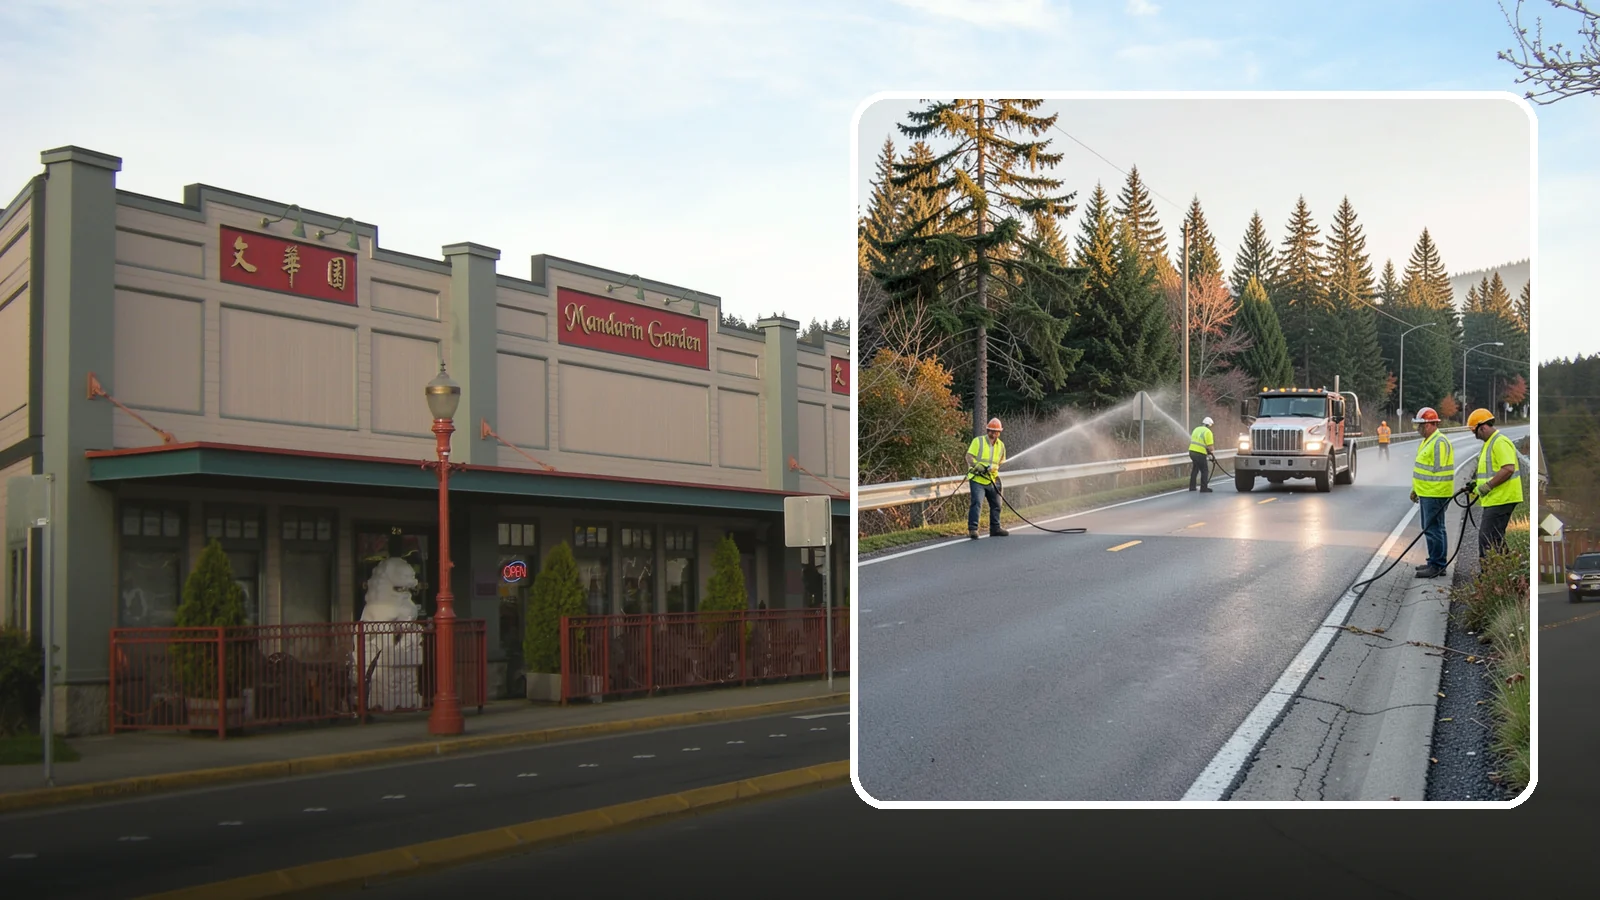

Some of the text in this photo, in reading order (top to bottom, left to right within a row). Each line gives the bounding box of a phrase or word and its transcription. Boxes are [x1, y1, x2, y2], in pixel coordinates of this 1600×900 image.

[231, 236, 346, 290] 文華園
[564, 302, 701, 352] Mandarin Garden
[834, 363, 846, 386] 文
[503, 566, 527, 578] OPEN
